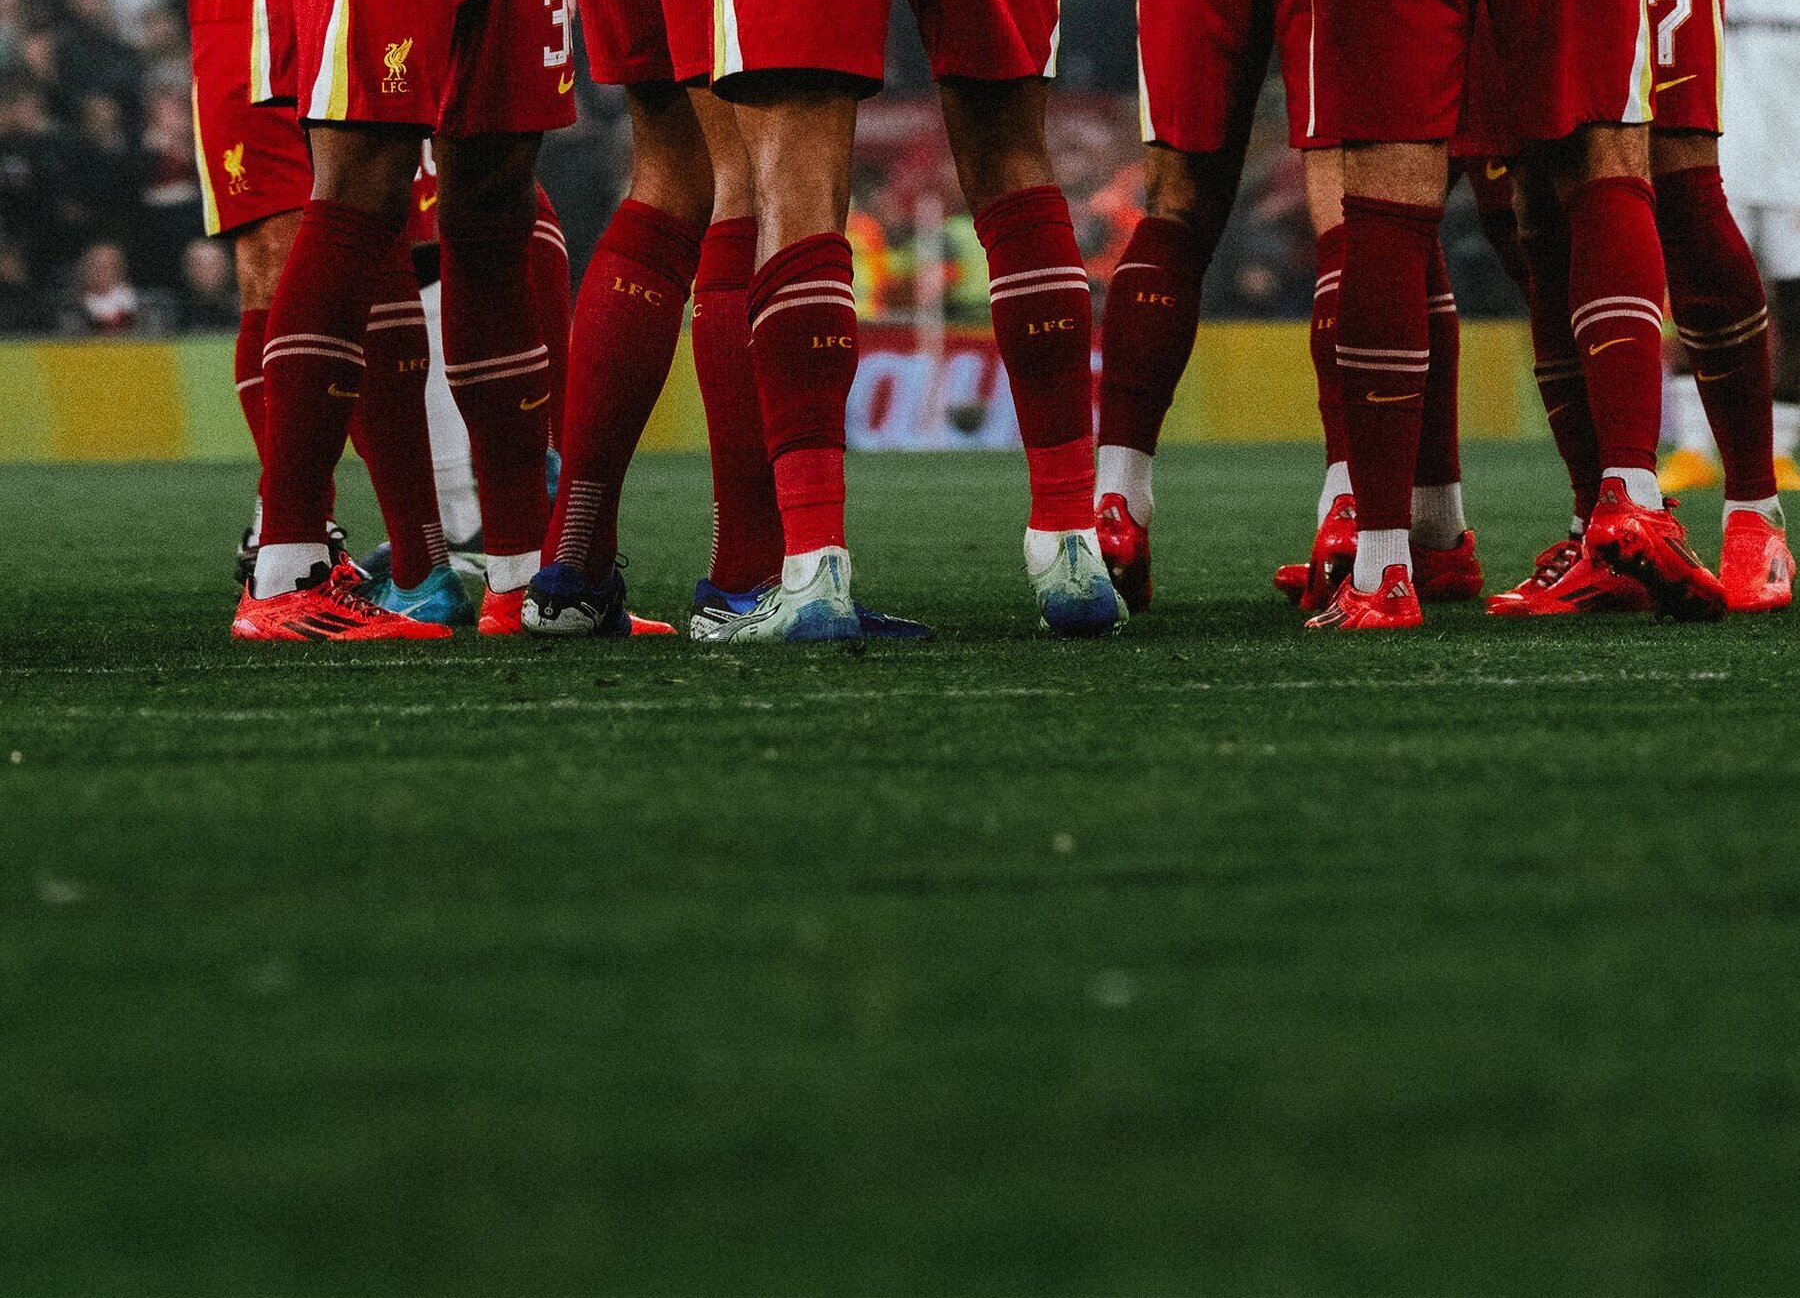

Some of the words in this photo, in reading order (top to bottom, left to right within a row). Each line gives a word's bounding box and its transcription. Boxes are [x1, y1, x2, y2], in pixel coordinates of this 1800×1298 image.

[612, 277, 662, 306] LFC
[1027, 318, 1074, 335] LFC
[812, 336, 852, 349] LFC
